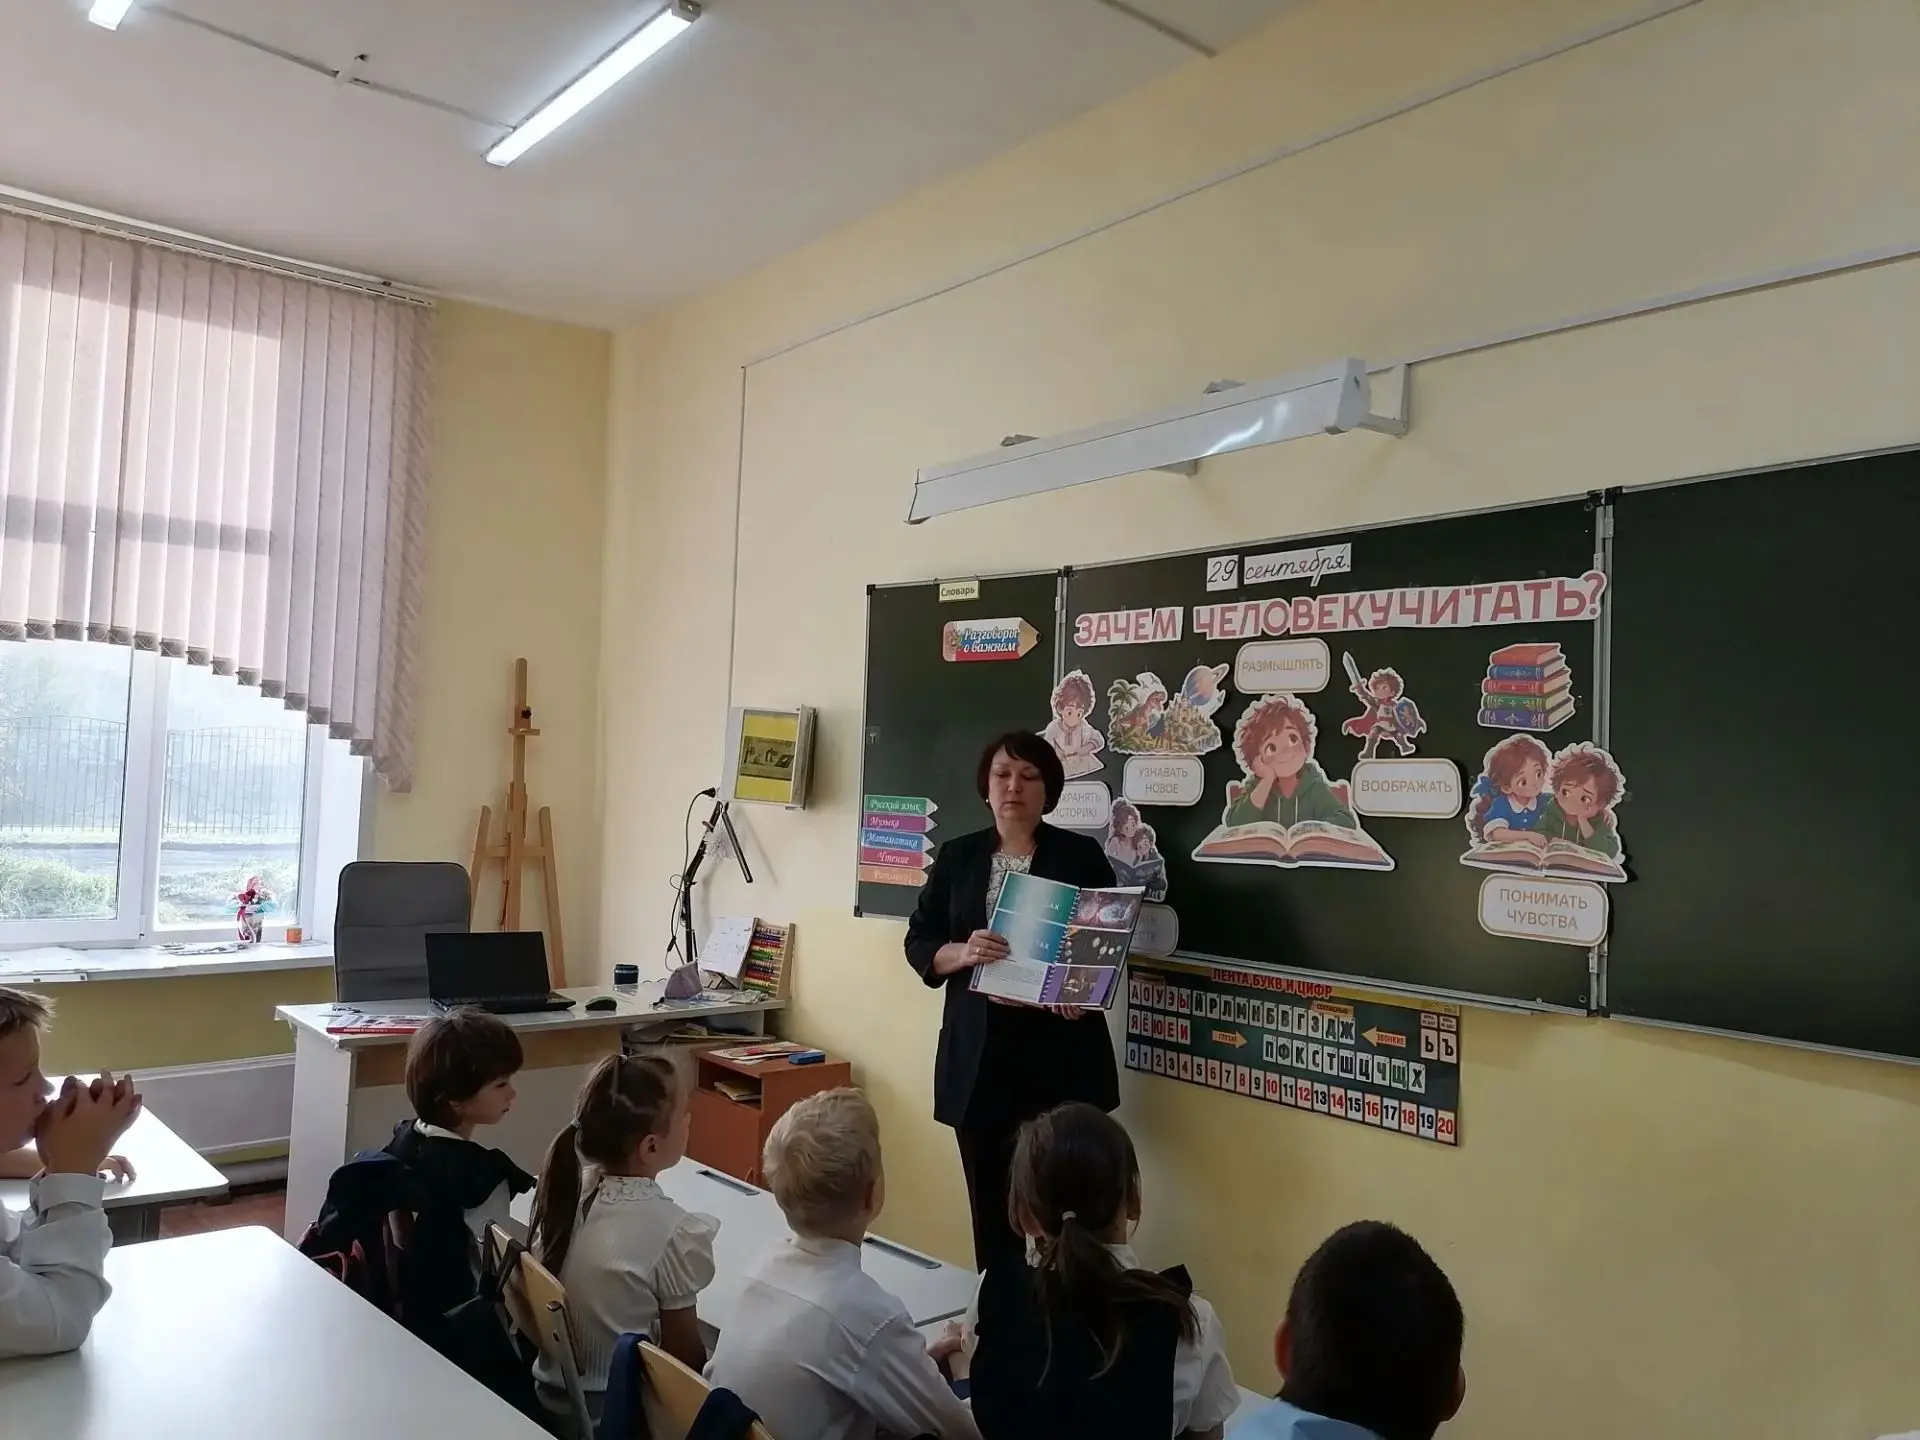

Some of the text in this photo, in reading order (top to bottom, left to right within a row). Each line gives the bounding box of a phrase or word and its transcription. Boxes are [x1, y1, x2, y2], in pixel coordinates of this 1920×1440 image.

[1207, 559, 1238, 583] 29
[940, 586, 976, 597] Словарь
[1076, 609, 1178, 644] ЗАЧЕМ
[964, 626, 1019, 643] Разговоры
[964, 640, 1017, 653] о важном
[1242, 658, 1324, 673] РАЗМЫШЛЯТЬ
[1139, 768, 1188, 778] УЗНАВАТЬ
[1145, 784, 1179, 794] НОВОЕ
[1361, 779, 1453, 793] ВООБРАЖАТЬ
[870, 799, 899, 811] Русский
[1058, 792, 1101, 803] ХРАНЯТЬ
[870, 816, 899, 828] Музыка
[867, 832, 918, 848] Математика
[877, 851, 909, 864] Чтение
[1500, 888, 1588, 909] ПОНИМАТЬ
[1507, 909, 1578, 929] ЧУВСТВА
[1212, 968, 1332, 997] ЛЕНТА БУКВ И ЦИФР
[1325, 1018, 1337, 1040] Д
[1339, 1020, 1354, 1041] Ж
[1376, 1033, 1405, 1046] ЗВОНКИЕ
[1265, 1040, 1274, 1058] П
[1296, 1046, 1305, 1065] К
[1327, 1052, 1336, 1071] Т
[1340, 1054, 1353, 1075] Ш
[1358, 1057, 1370, 1080] Ц
[1392, 1064, 1407, 1088] Щ
[1411, 1068, 1422, 1088] Х
[1266, 1079, 1278, 1094] 10
[1283, 1083, 1294, 1098] 11
[1298, 1086, 1310, 1102] 12
[1314, 1090, 1327, 1105] 13
[1331, 1093, 1344, 1109] 14
[1348, 1096, 1361, 1112] 15
[1366, 1100, 1379, 1117] 16
[1384, 1104, 1398, 1121] 17
[1402, 1109, 1415, 1125] 18
[1420, 1113, 1434, 1130] 19
[1438, 1117, 1453, 1135] 20
